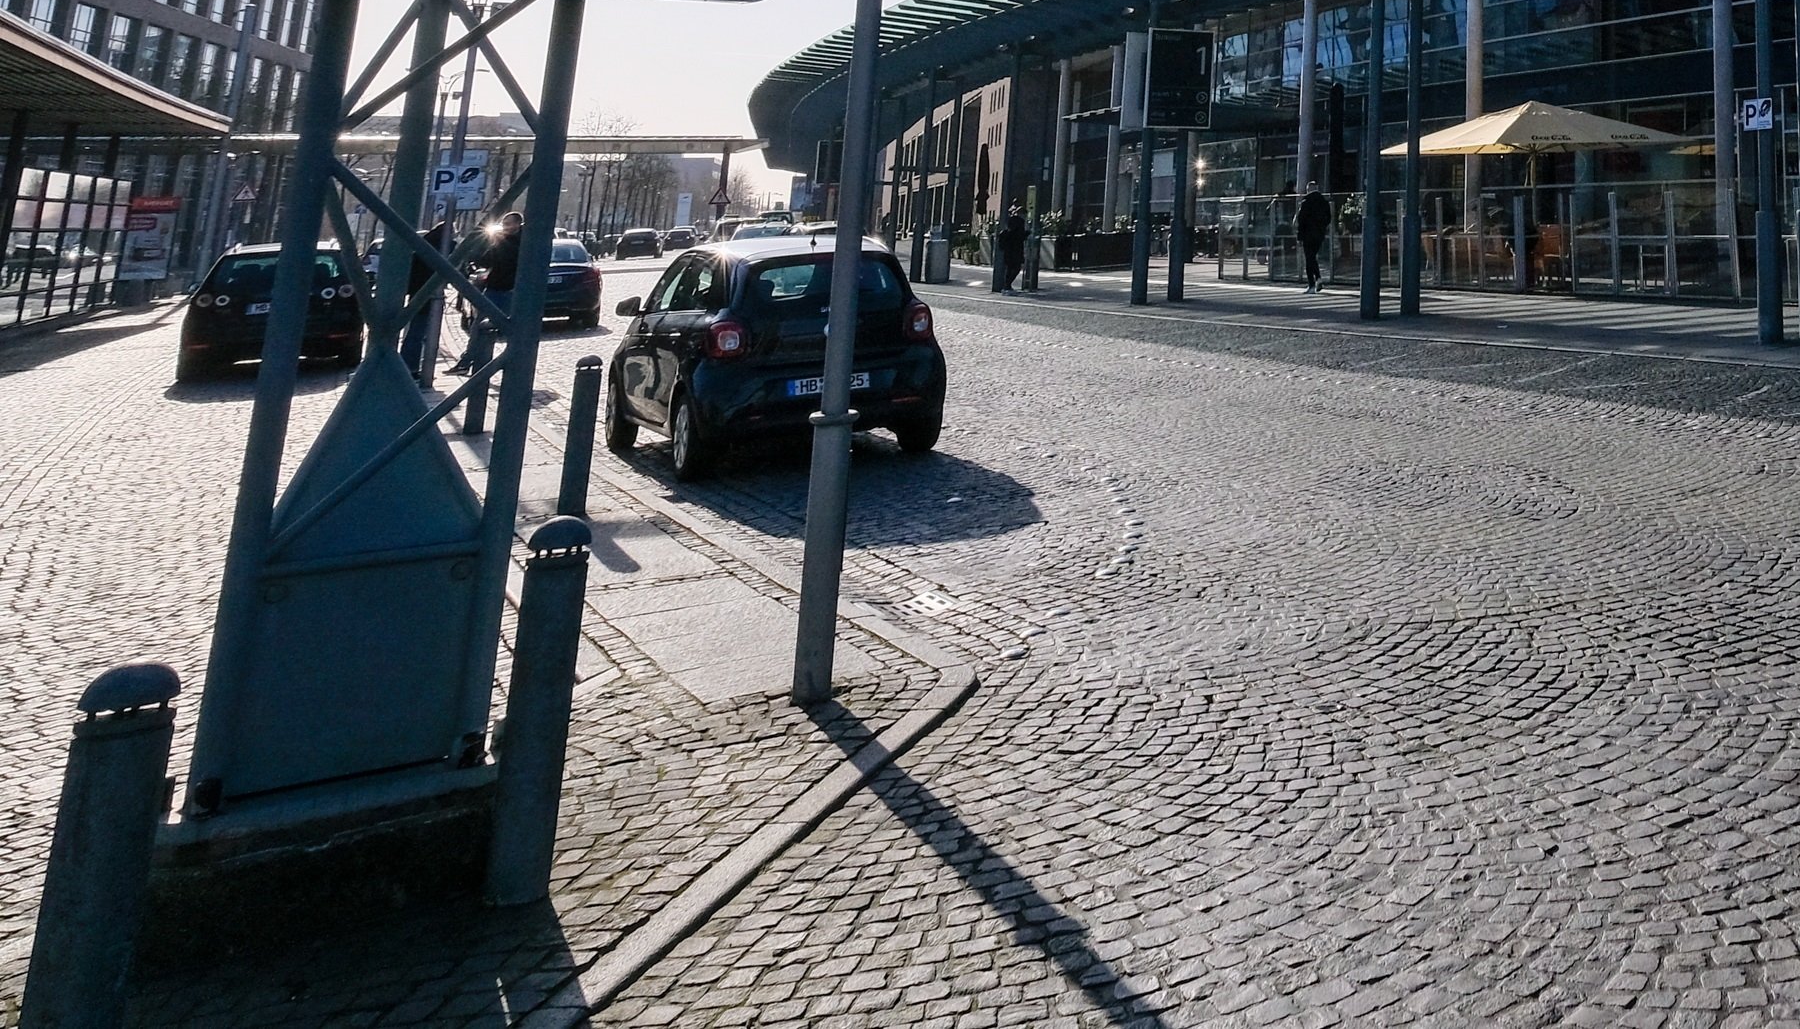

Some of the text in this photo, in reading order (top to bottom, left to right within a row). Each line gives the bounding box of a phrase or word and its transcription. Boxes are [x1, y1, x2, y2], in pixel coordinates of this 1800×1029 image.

[1195, 46, 1207, 76] 1
[1745, 104, 1757, 127] P
[434, 170, 455, 191] P
[799, 379, 818, 394] HB
